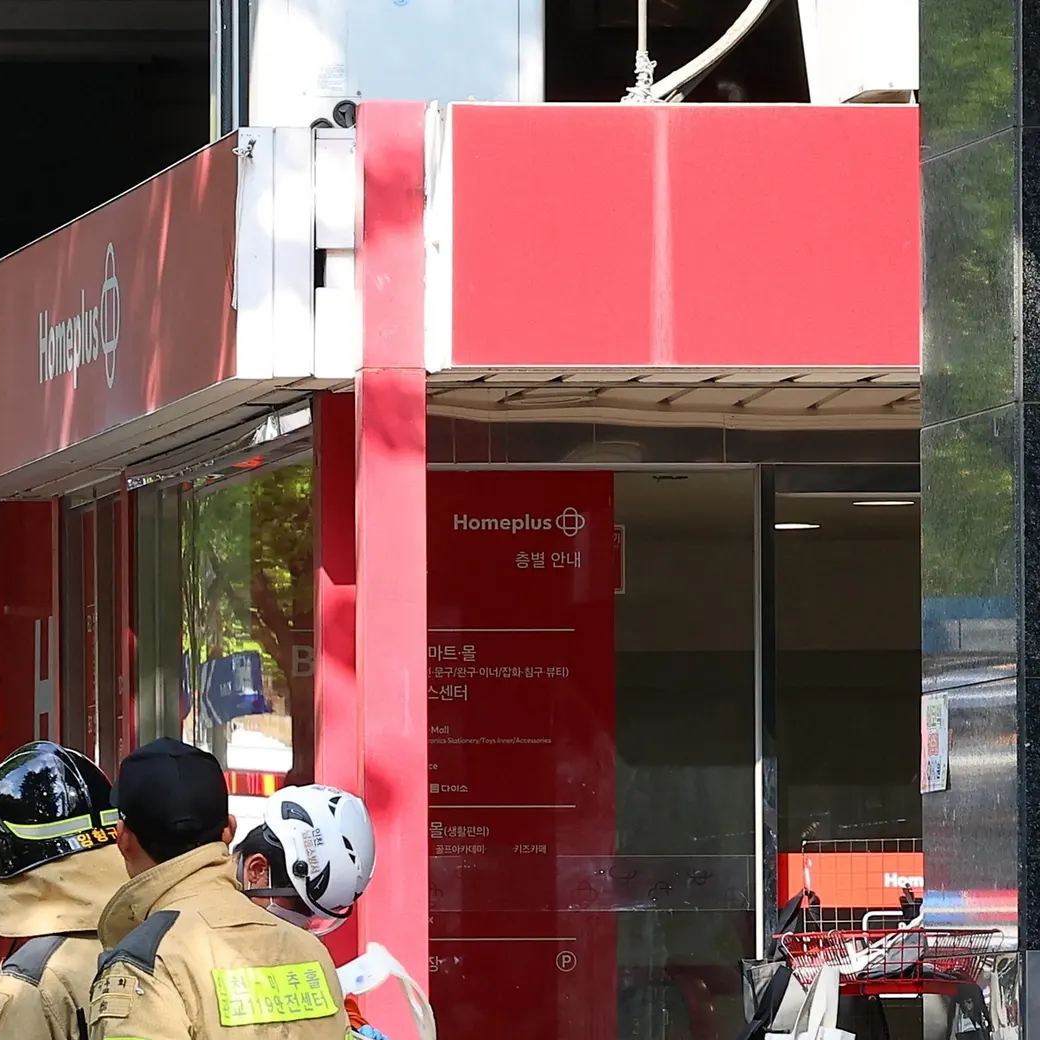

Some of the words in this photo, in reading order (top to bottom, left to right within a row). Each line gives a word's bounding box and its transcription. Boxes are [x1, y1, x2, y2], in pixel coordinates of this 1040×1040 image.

[40, 289, 99, 389] Homeplus
[453, 514, 552, 534] Homeplus
[515, 551, 546, 568] 층별
[551, 551, 581, 568] 안내
[428, 645, 476, 661] 마트·몰
[441, 784, 468, 793] 다이소
[430, 821, 490, 839] 몰(생활편의)
